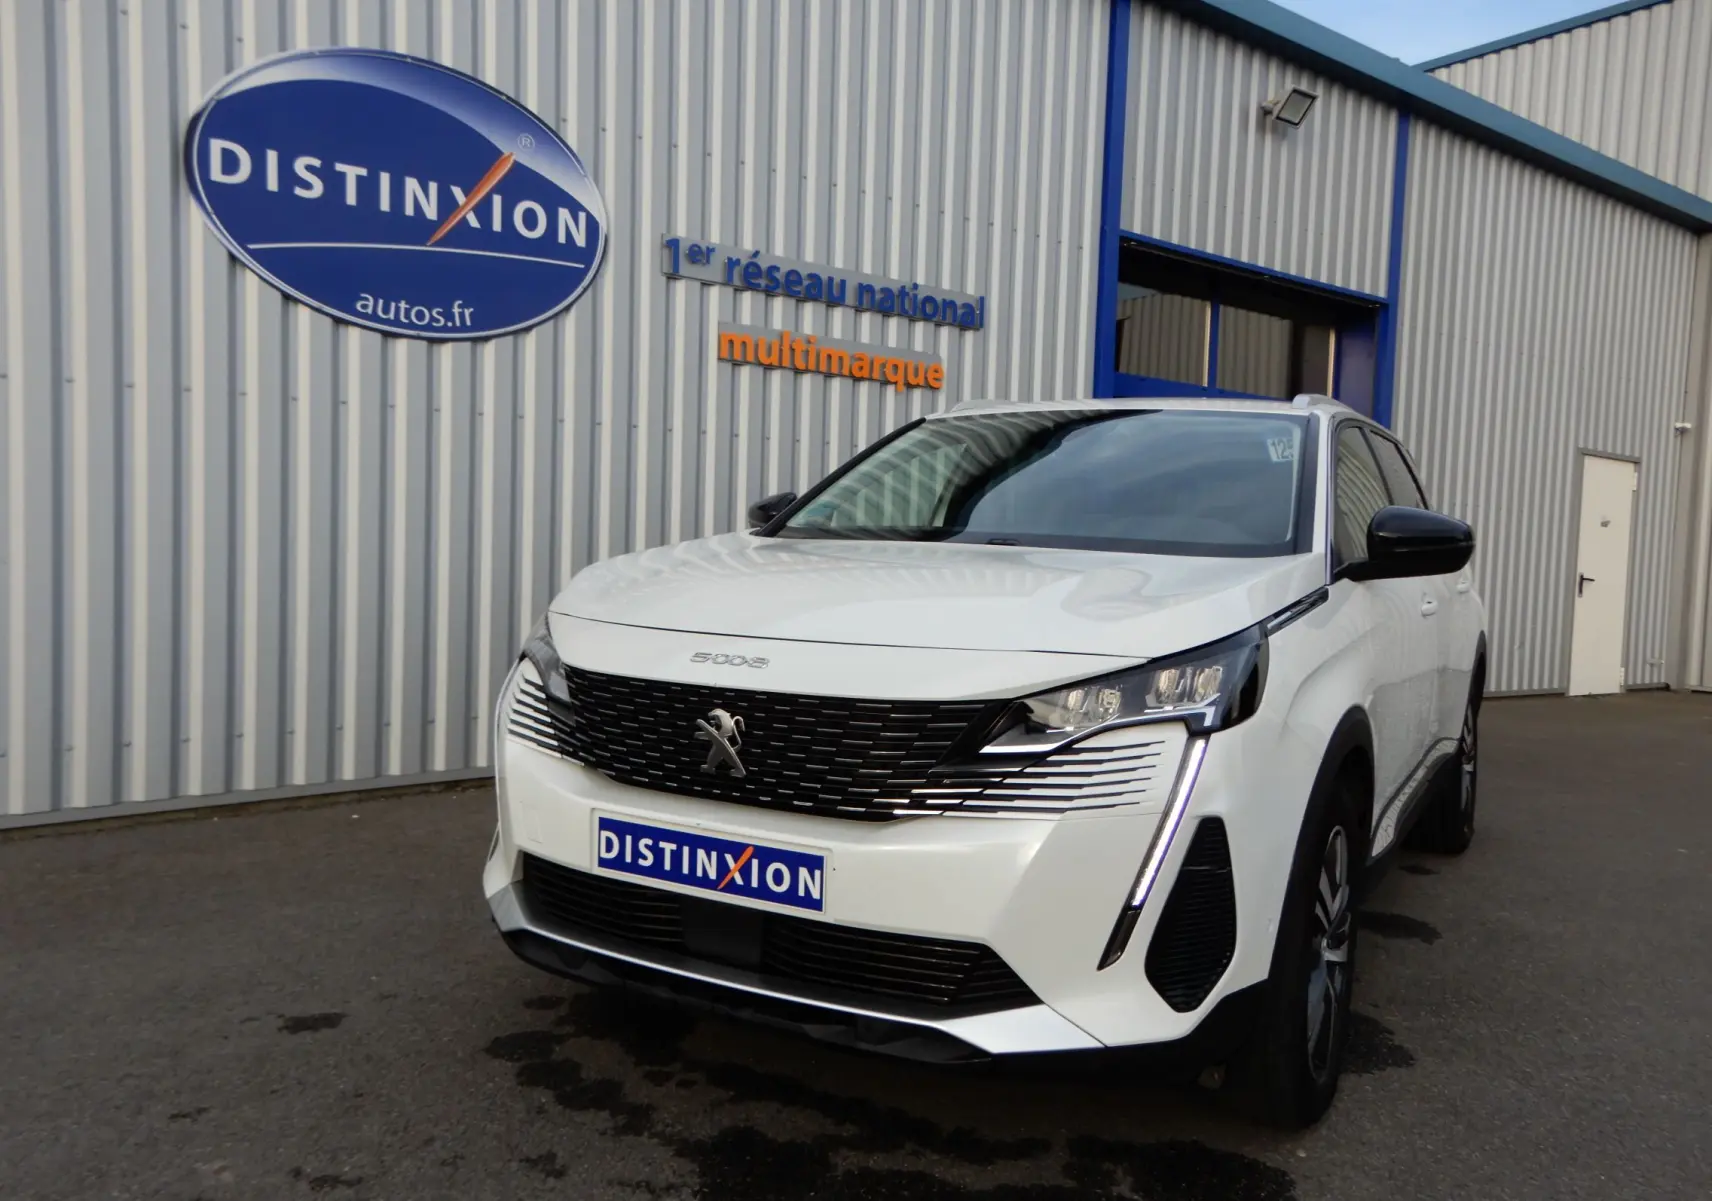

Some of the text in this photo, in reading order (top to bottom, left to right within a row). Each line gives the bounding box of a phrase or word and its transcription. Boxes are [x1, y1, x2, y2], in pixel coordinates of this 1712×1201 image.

[208, 138, 588, 248] DISTINXION
[355, 292, 475, 328] autos.fr
[665, 237, 985, 329] 1er réseau national
[719, 330, 945, 392] multimarque
[690, 652, 770, 669] 5008
[600, 829, 822, 900] DISTINXION
